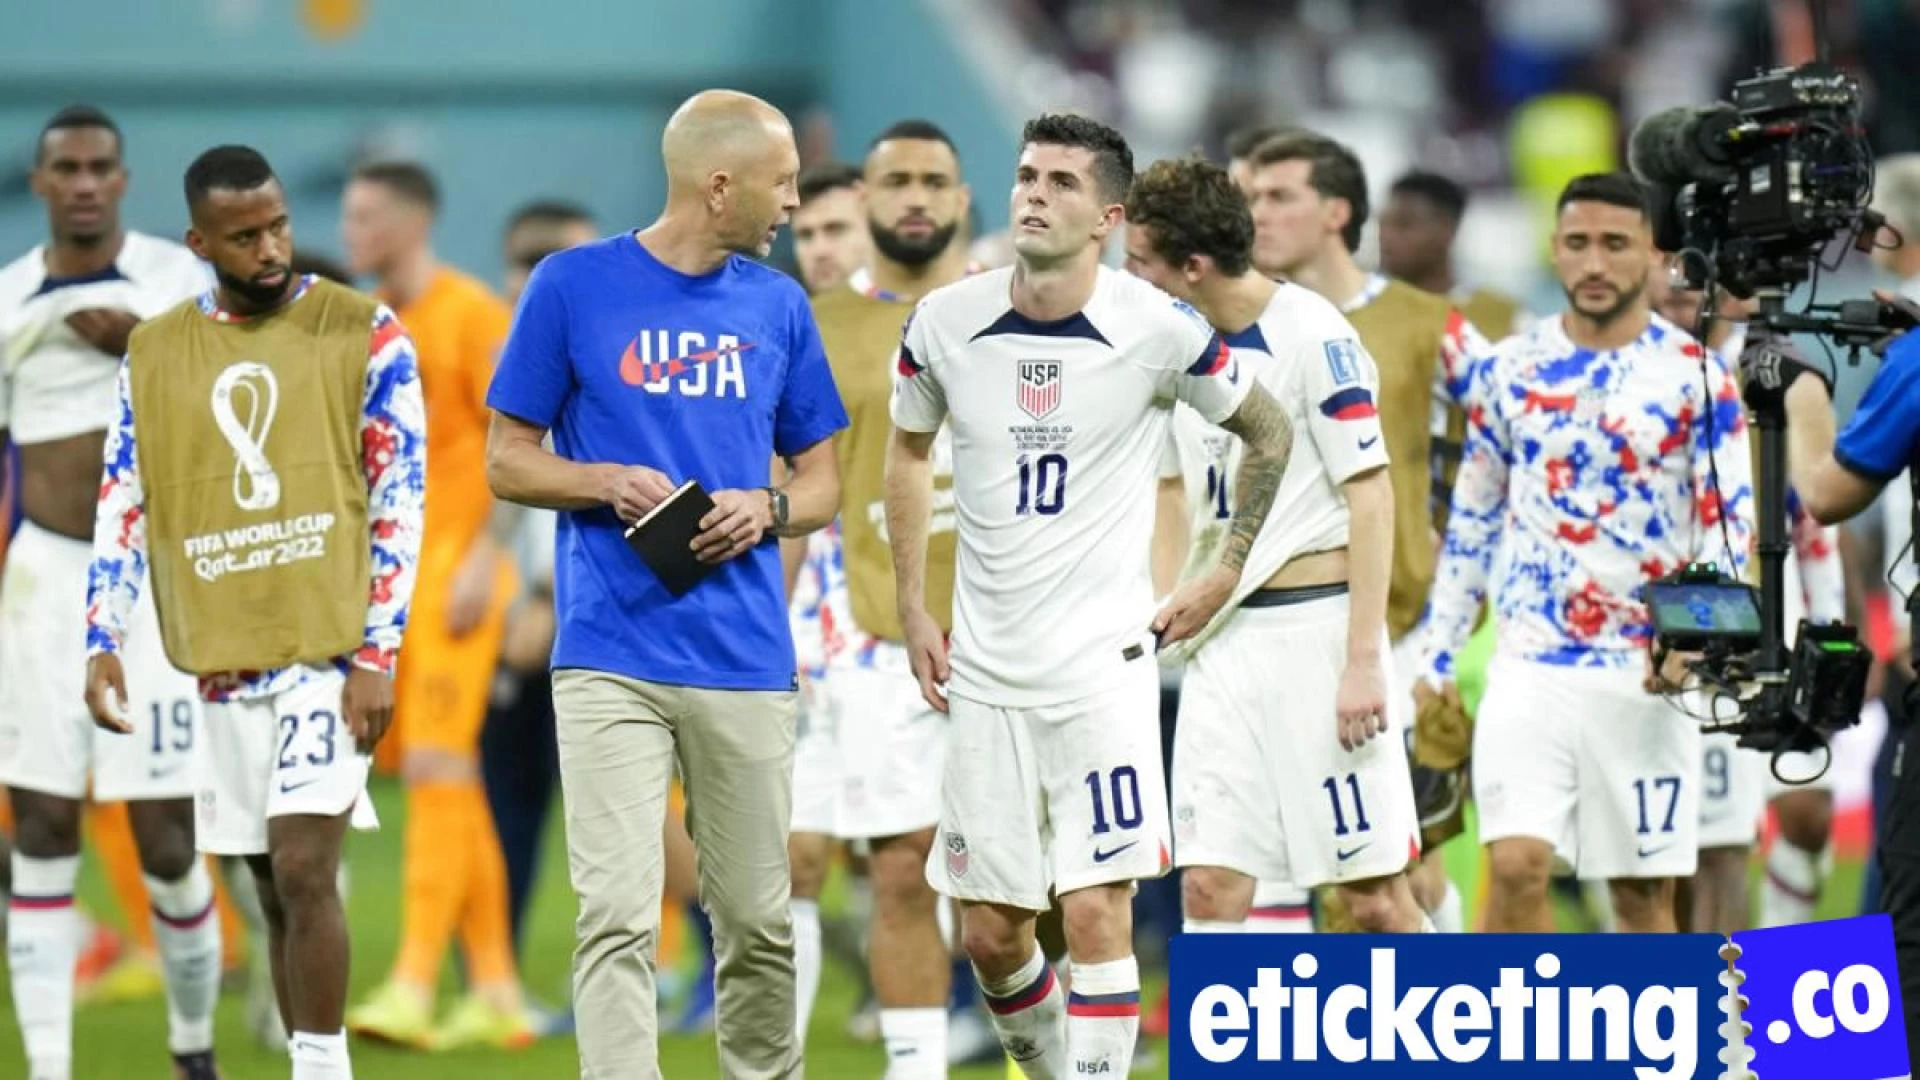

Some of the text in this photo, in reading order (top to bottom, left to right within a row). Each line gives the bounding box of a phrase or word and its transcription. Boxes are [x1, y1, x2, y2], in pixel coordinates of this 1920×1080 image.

[641, 329, 746, 398] USA
[1016, 454, 1068, 515] 10
[184, 532, 225, 558] FIFA
[294, 512, 335, 534] CUP
[152, 698, 193, 752] 19
[279, 709, 336, 769] 23
[1085, 765, 1143, 834] 10
[1323, 773, 1370, 836] 11
[1633, 776, 1681, 835] 17
[1076, 1060, 1111, 1075] USA
